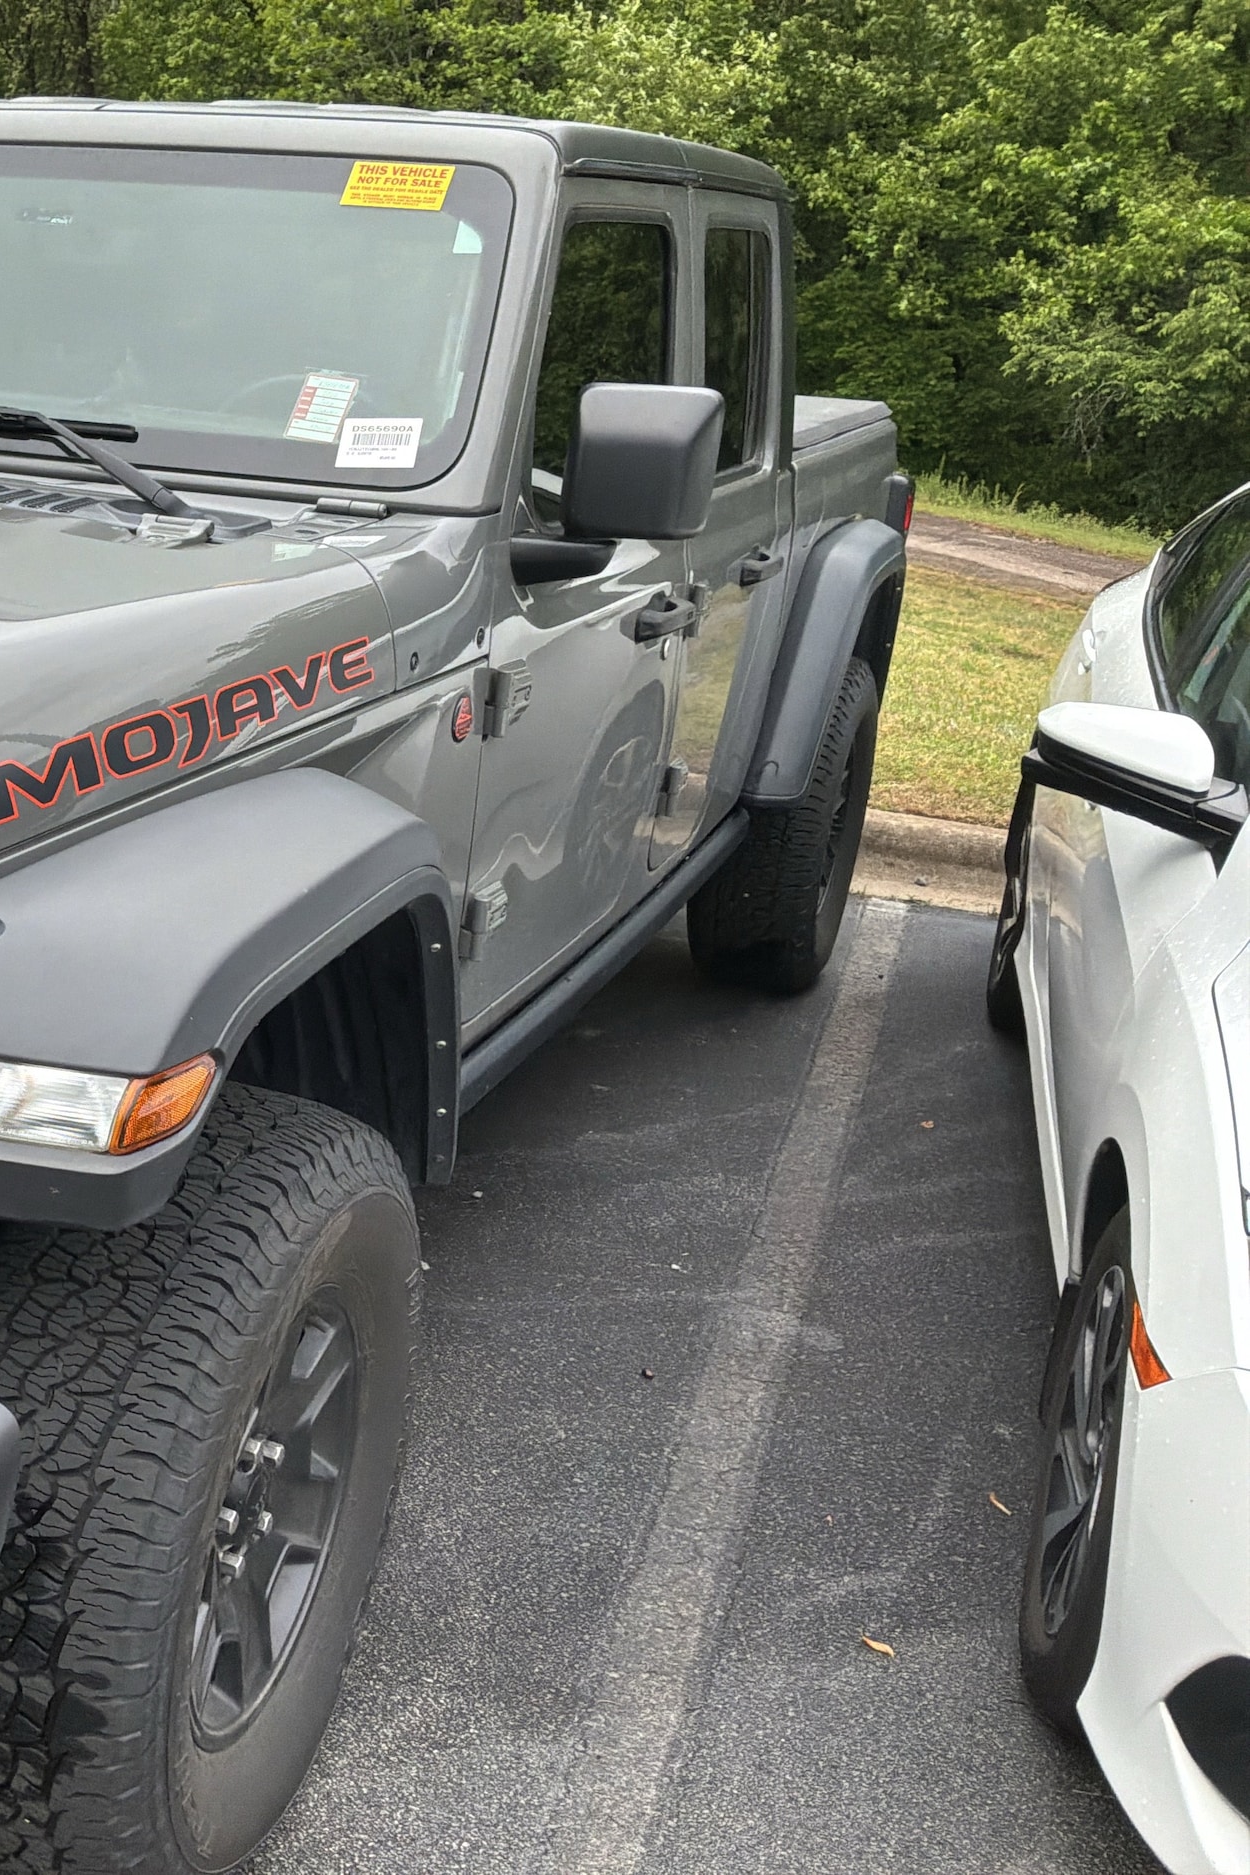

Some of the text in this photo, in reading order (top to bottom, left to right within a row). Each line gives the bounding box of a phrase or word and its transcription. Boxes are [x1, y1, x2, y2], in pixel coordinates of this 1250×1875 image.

[359, 165, 449, 178] THIS VEHICLE
[357, 176, 444, 188] NOT FOR SALE
